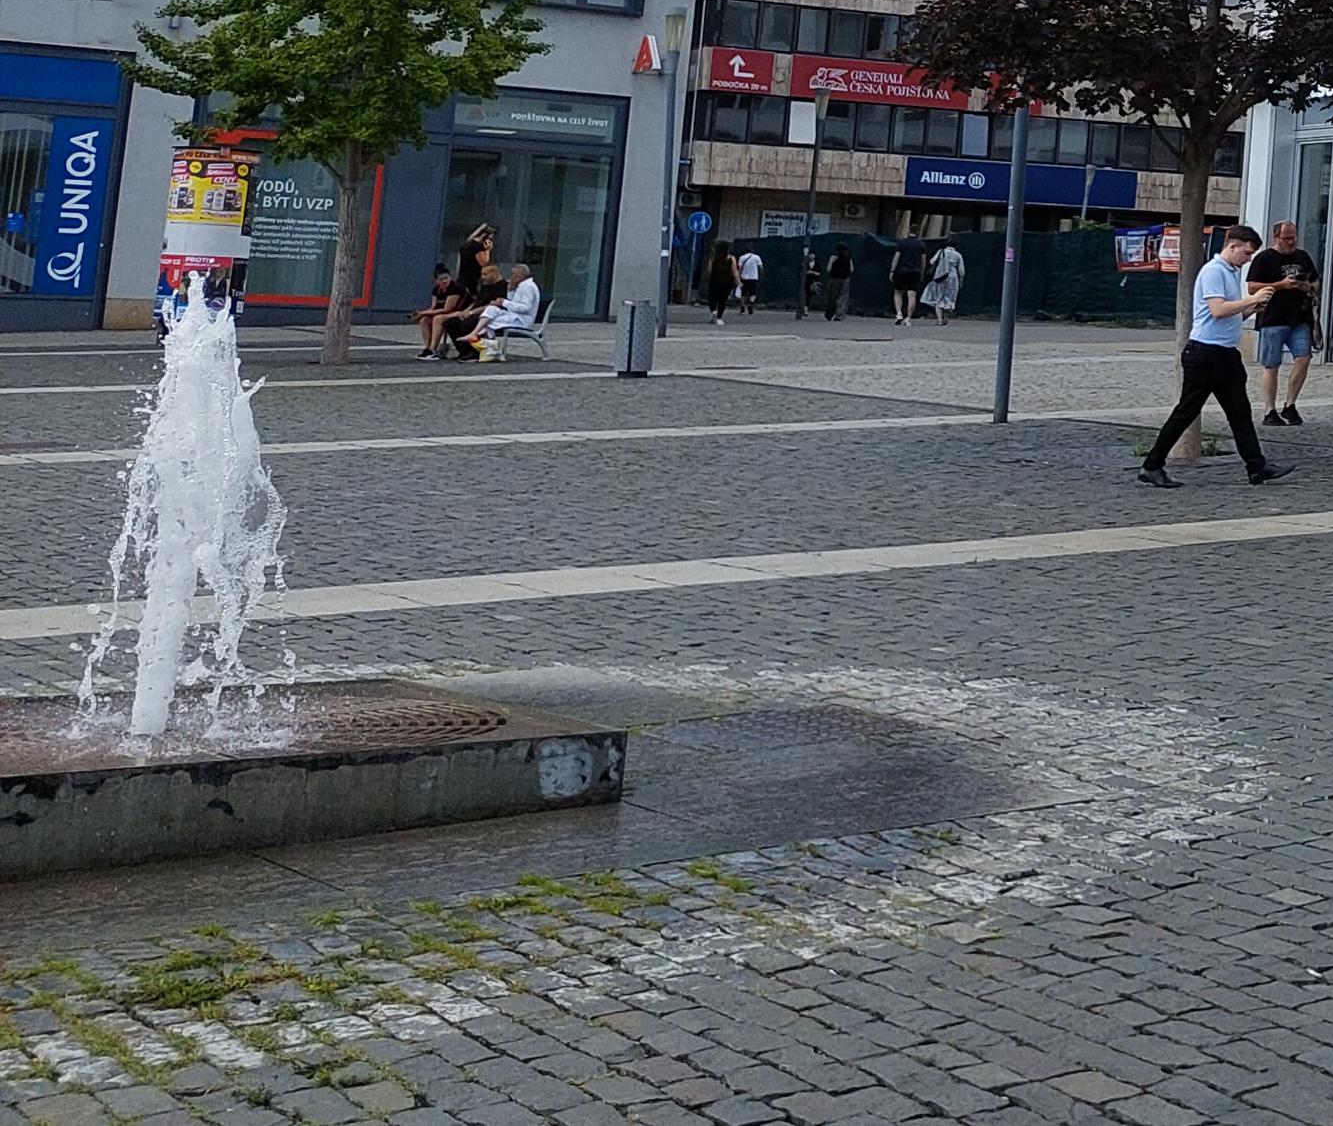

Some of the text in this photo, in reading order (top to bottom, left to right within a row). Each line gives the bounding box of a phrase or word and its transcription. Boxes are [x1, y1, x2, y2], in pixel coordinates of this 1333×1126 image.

[850, 70, 903, 84] GENERALI
[712, 80, 749, 89] POBOČKA
[849, 81, 884, 95] ČESKÁ
[587, 117, 609, 128] ŽIVOT
[58, 130, 99, 235] UNIQA
[920, 170, 967, 185] Allianz
[262, 194, 334, 211] BÝT U VZP
